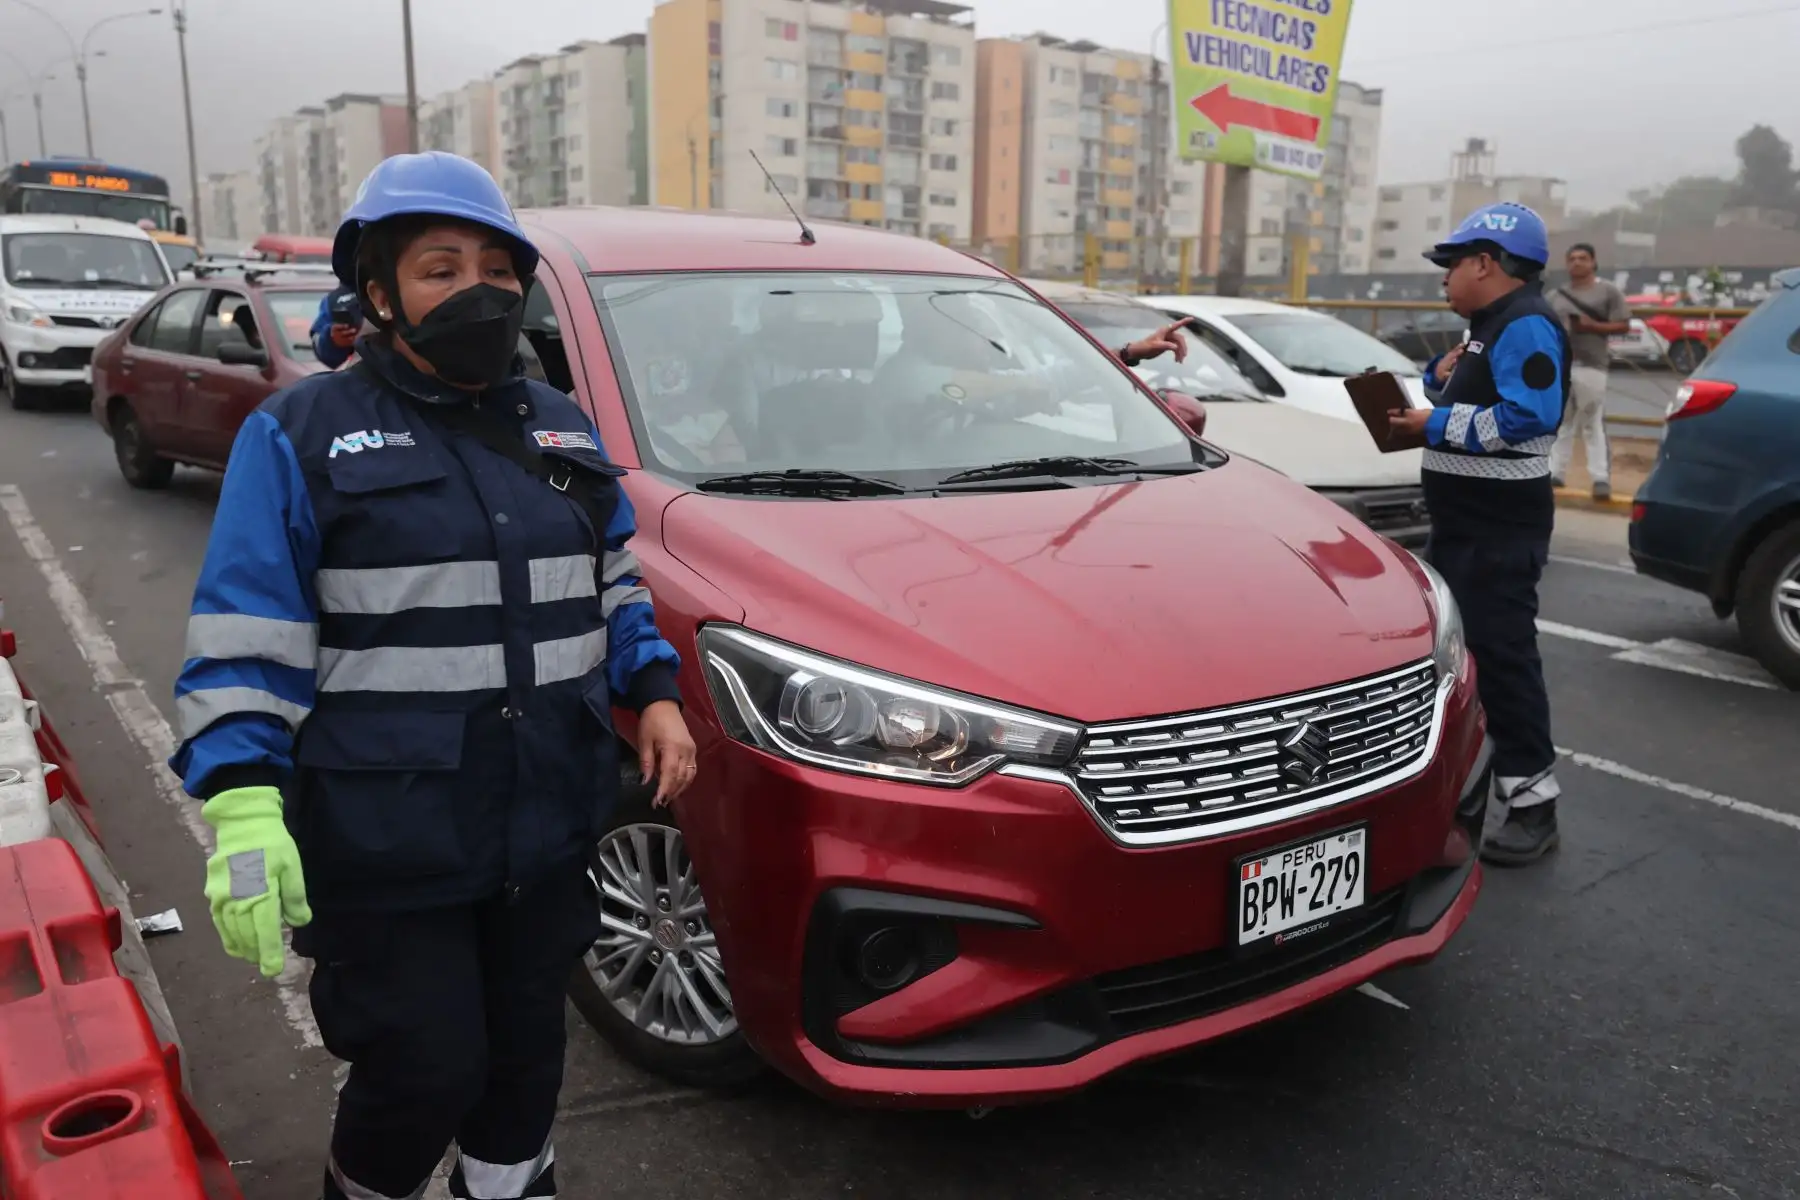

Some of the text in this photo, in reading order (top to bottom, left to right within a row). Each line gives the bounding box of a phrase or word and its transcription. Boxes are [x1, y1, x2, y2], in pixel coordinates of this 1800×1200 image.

[1186, 32, 1329, 93] VEHICULARES
[1473, 213, 1518, 232] ATU
[328, 430, 384, 458] ATU
[1282, 842, 1326, 870] PERU
[1242, 851, 1360, 933] BPW-279
